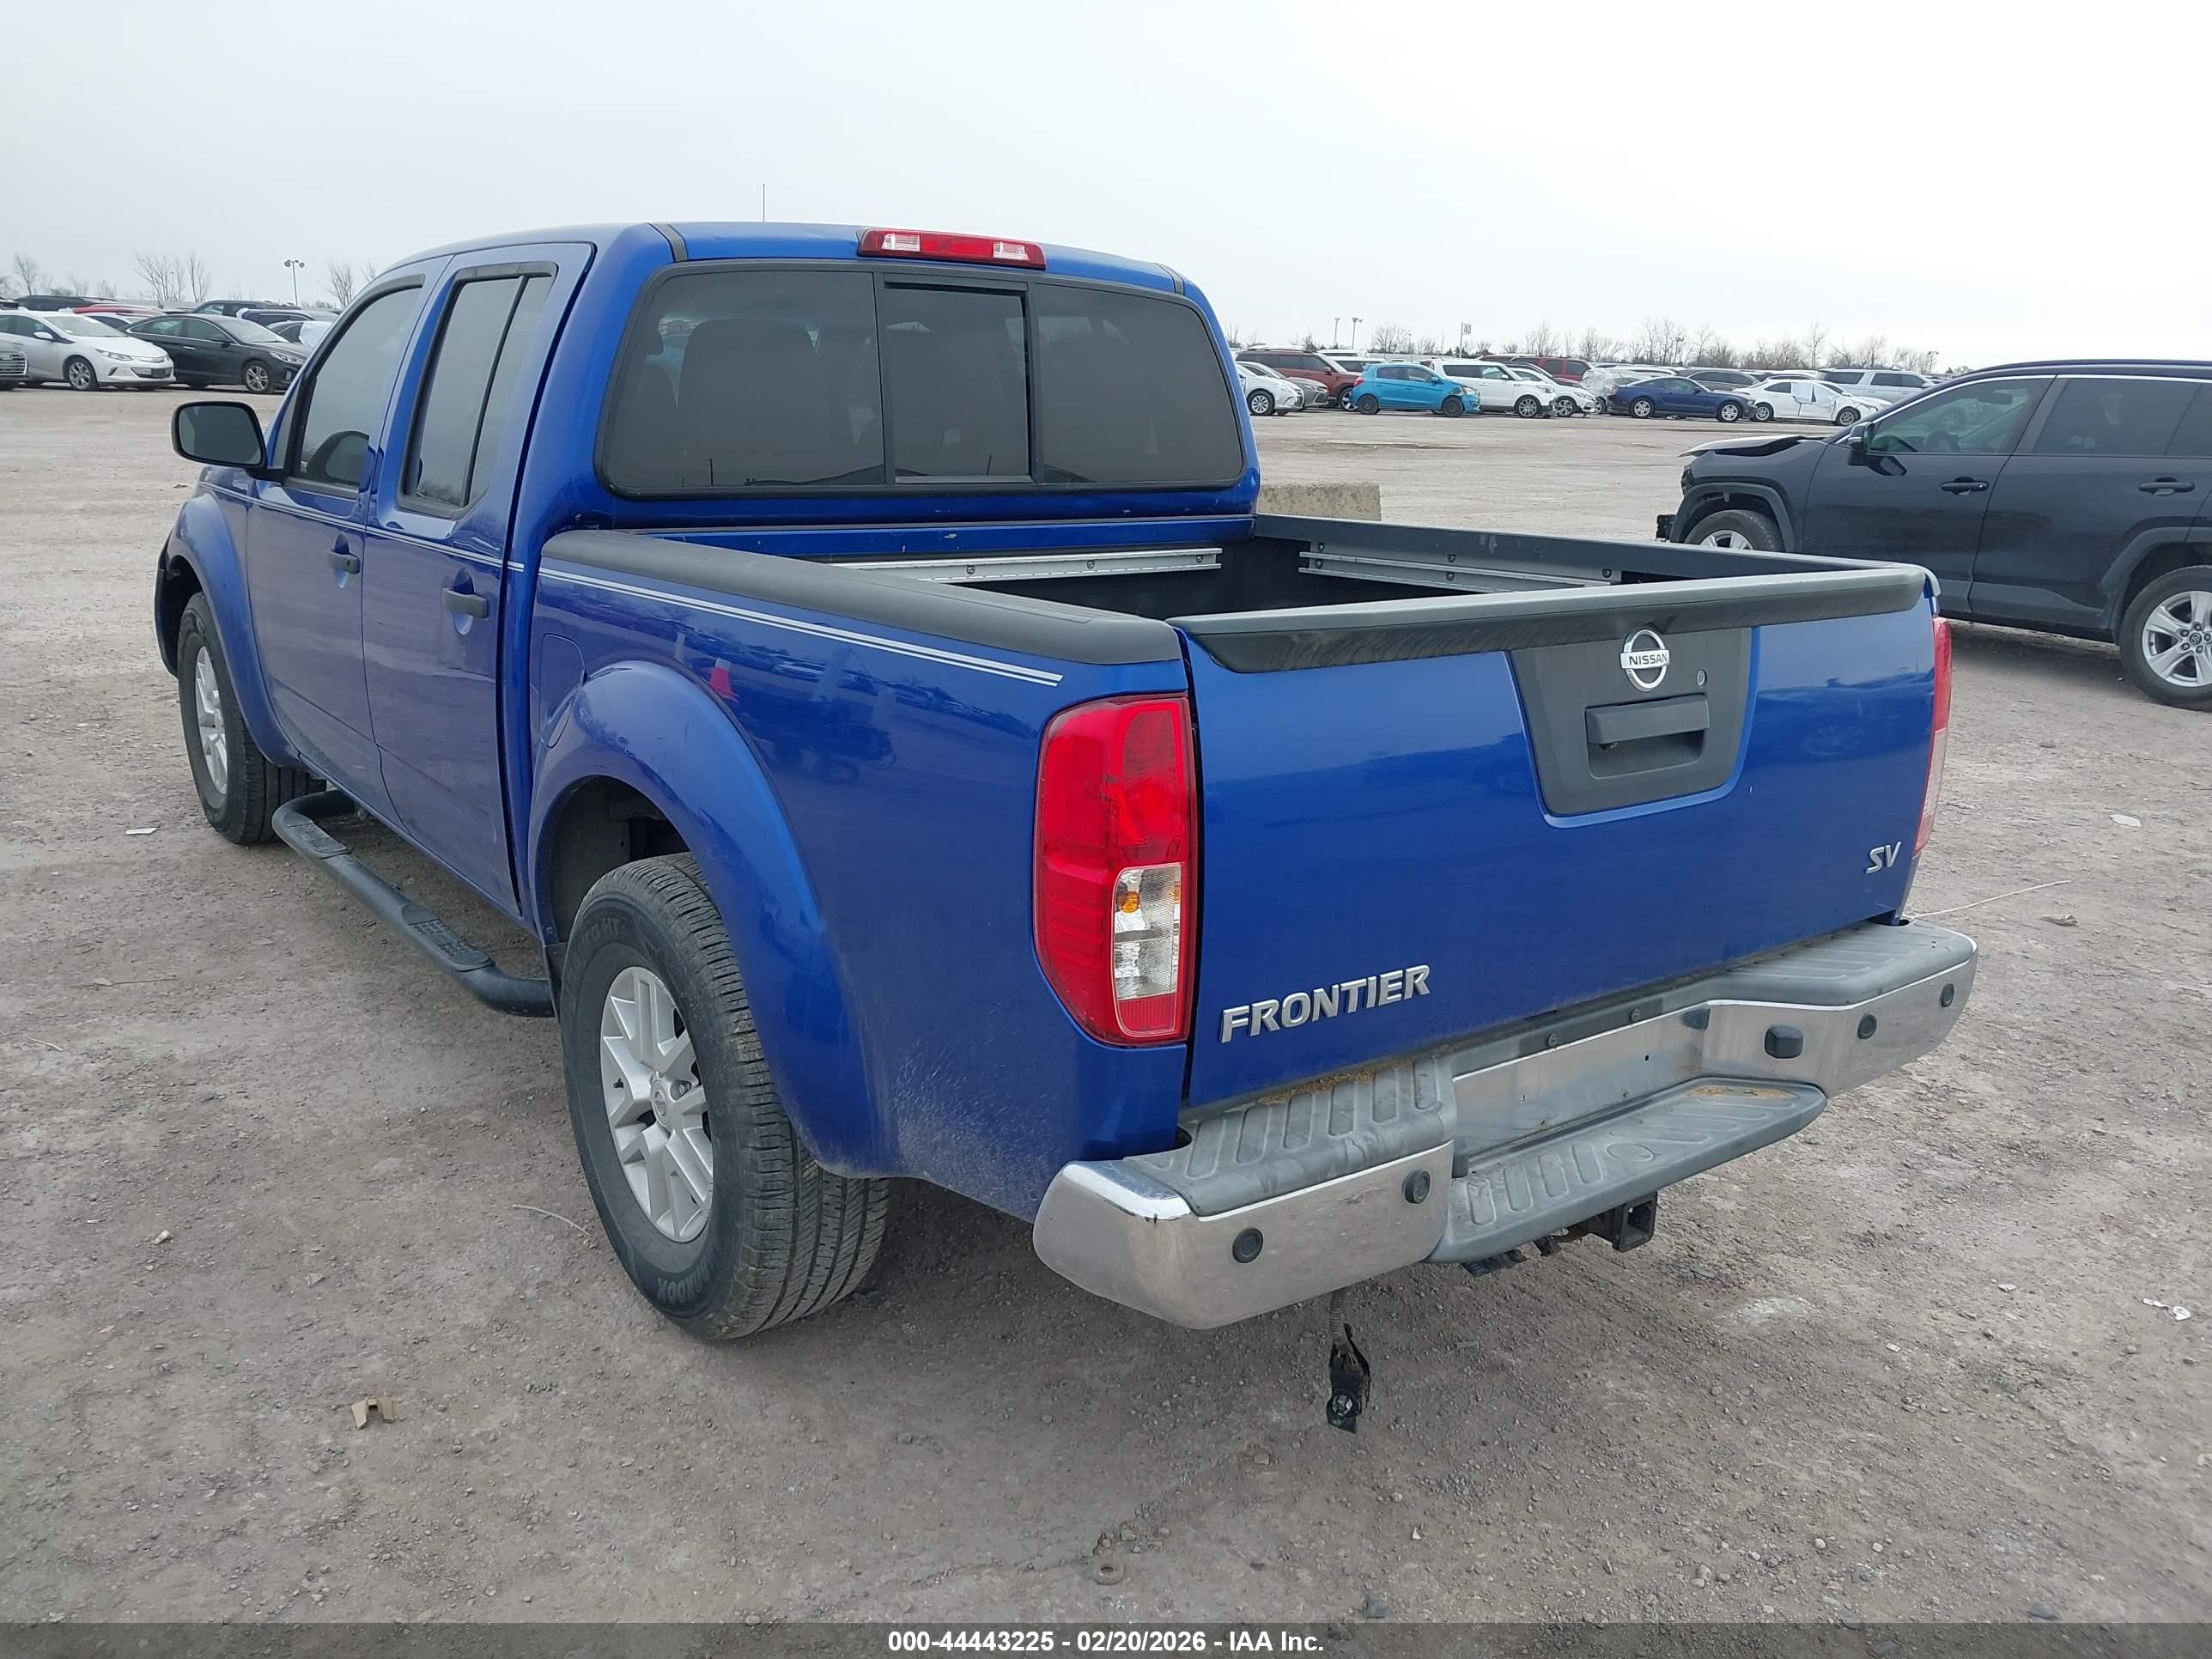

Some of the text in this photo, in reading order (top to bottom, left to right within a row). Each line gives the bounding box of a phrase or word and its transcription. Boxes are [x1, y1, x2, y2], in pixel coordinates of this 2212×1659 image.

[1628, 653, 1668, 665] NISSAN
[1865, 841, 1902, 874] SV
[1219, 964, 1431, 1044] FRONTIER
